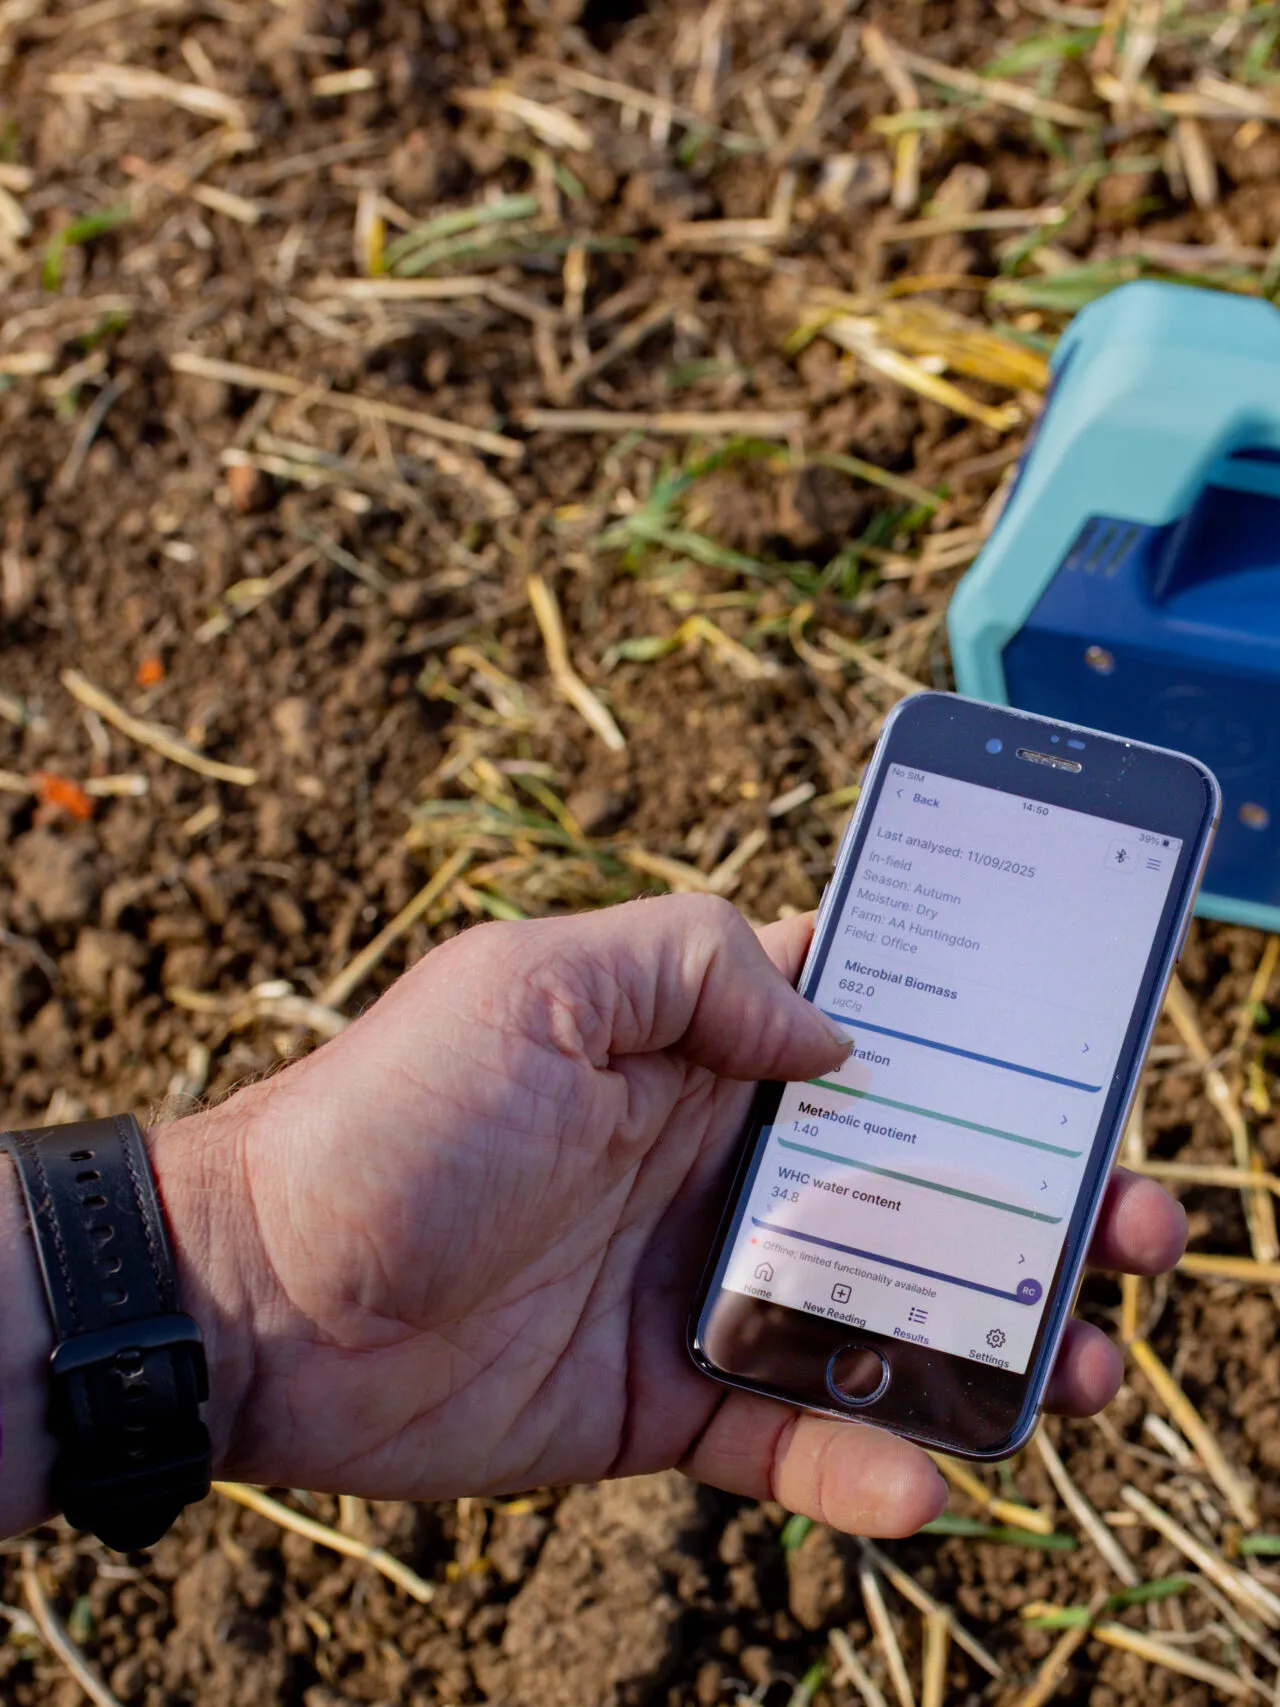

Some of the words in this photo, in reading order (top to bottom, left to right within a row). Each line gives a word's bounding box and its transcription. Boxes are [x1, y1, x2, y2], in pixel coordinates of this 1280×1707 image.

[892, 767, 905, 778] No
[907, 771, 925, 783] SIM
[912, 793, 940, 808] Back
[1022, 802, 1049, 816] 14:50
[1139, 833, 1160, 846] 39%
[868, 851, 913, 871] In-field
[876, 827, 903, 843] Last
[905, 835, 963, 859] analysed:
[967, 850, 1036, 878] 11/09/2025
[863, 869, 911, 891] Season:
[914, 884, 961, 904] Autumn
[856, 888, 913, 912] Moisture:
[916, 904, 938, 920] Dry
[850, 906, 885, 924] Farm:
[888, 917, 905, 931] AA
[909, 922, 981, 951] Huntingdon
[844, 925, 877, 942] Field:
[881, 935, 918, 954] Office
[838, 978, 875, 997] 682.0
[844, 959, 903, 984] Microbial
[904, 976, 958, 1000] Biomass
[850, 1045, 891, 1066] iration
[792, 1120, 819, 1137] 1.40
[798, 1101, 861, 1128] Metabolic
[863, 1121, 917, 1144] quotient
[770, 1186, 800, 1203] 34.8
[778, 1166, 811, 1184] WHC
[813, 1178, 850, 1196] water
[852, 1190, 902, 1212] content
[799, 1251, 832, 1268] limited
[834, 1260, 893, 1287] functionality
[894, 1278, 937, 1298] available
[744, 1284, 772, 1299] Home
[1022, 1286, 1036, 1296] RC
[803, 1300, 825, 1315] New
[826, 1307, 867, 1328] Reading
[893, 1326, 930, 1345] Results
[968, 1349, 1010, 1369] Settings
